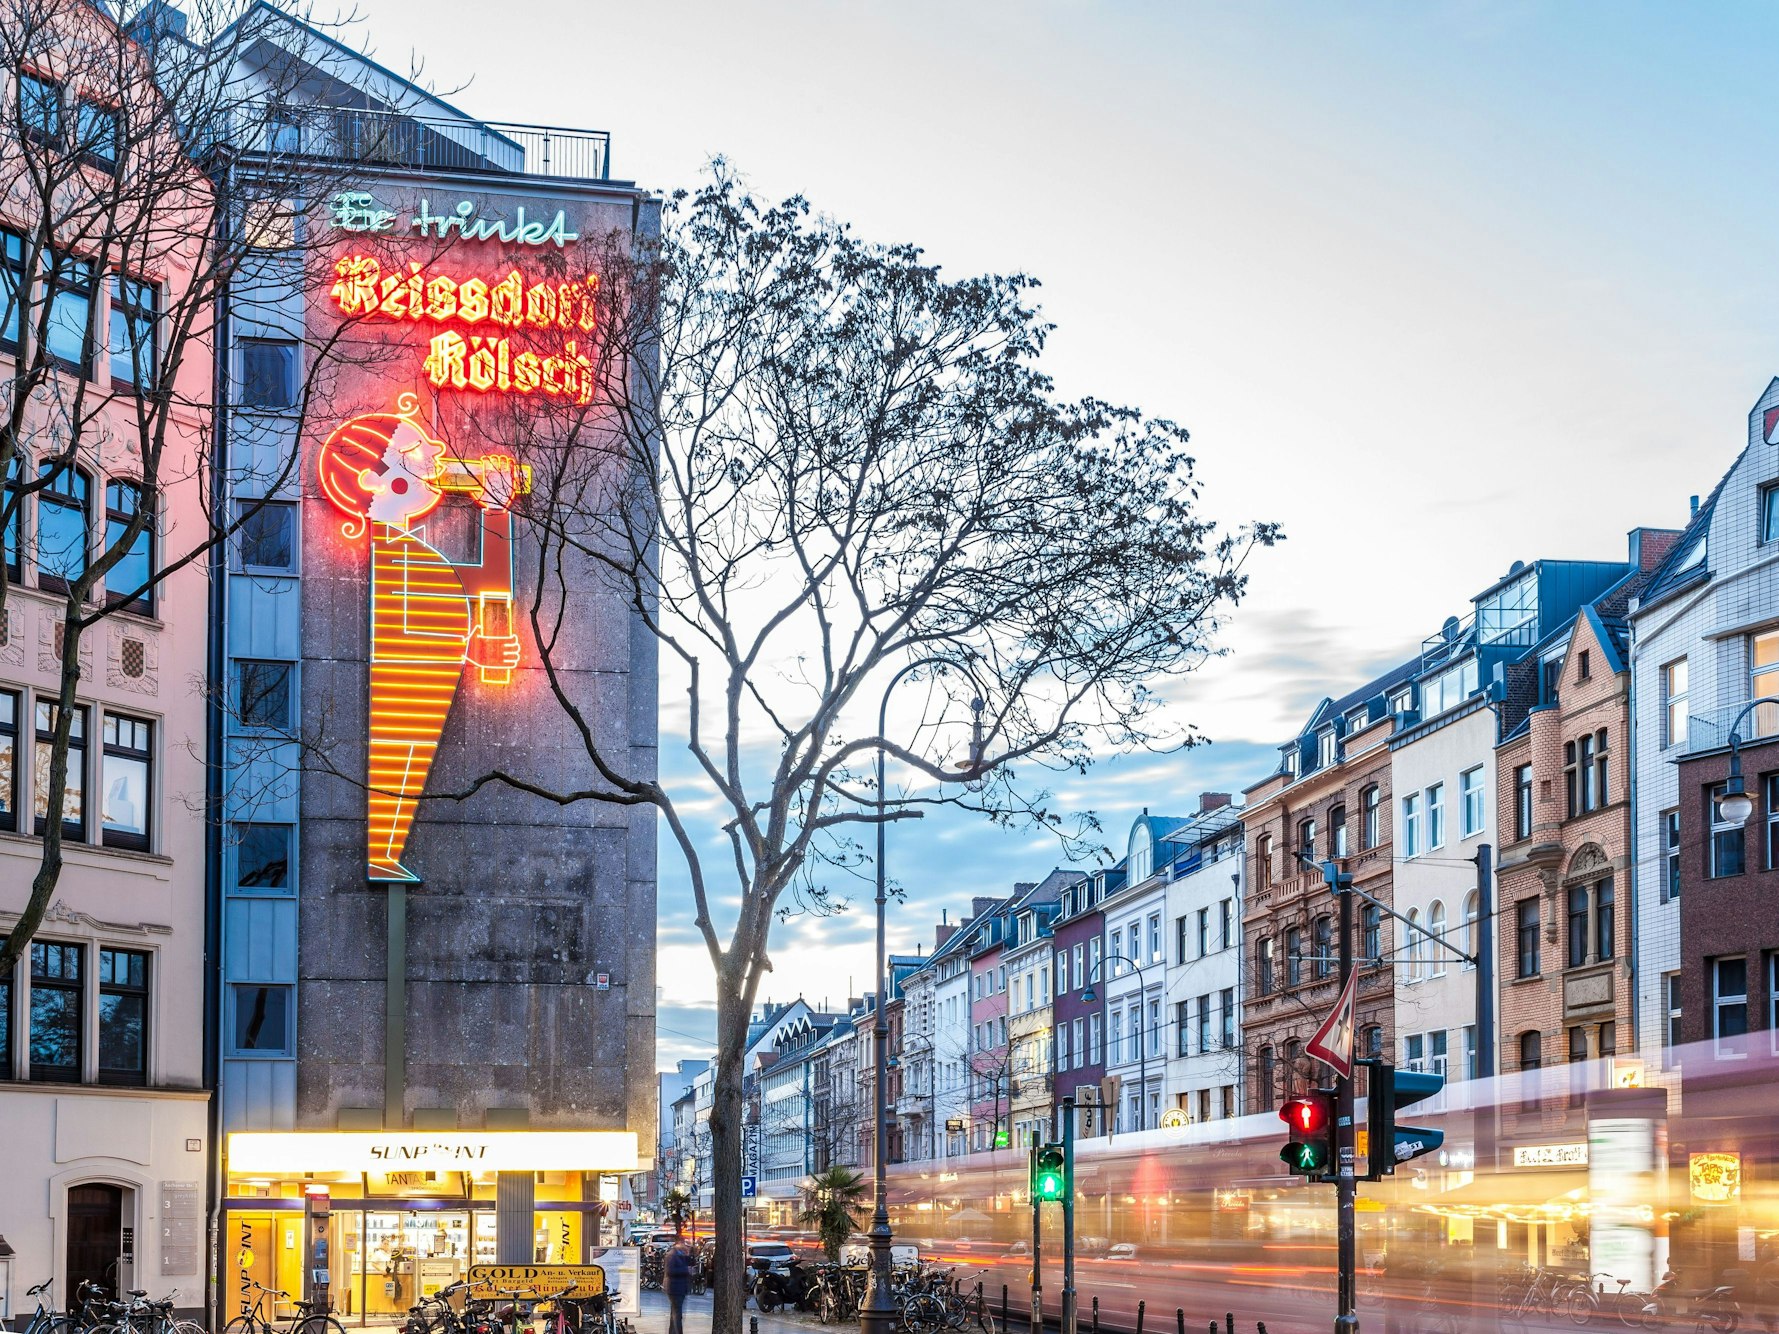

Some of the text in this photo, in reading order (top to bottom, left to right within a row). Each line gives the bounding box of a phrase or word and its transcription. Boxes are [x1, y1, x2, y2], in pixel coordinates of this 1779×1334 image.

[412, 198, 579, 248] trinkt
[330, 255, 600, 333] Reissdorf
[422, 329, 595, 405] Kölsch
[369, 1144, 489, 1160] SUNPINT
[1698, 1162, 1723, 1175] TAPAS
[1704, 1173, 1720, 1184] BAR
[742, 1178, 752, 1196] P
[164, 1201, 171, 1209] 3
[164, 1228, 171, 1237] 2
[163, 1256, 170, 1265] 1
[472, 1268, 538, 1279] GOLD
